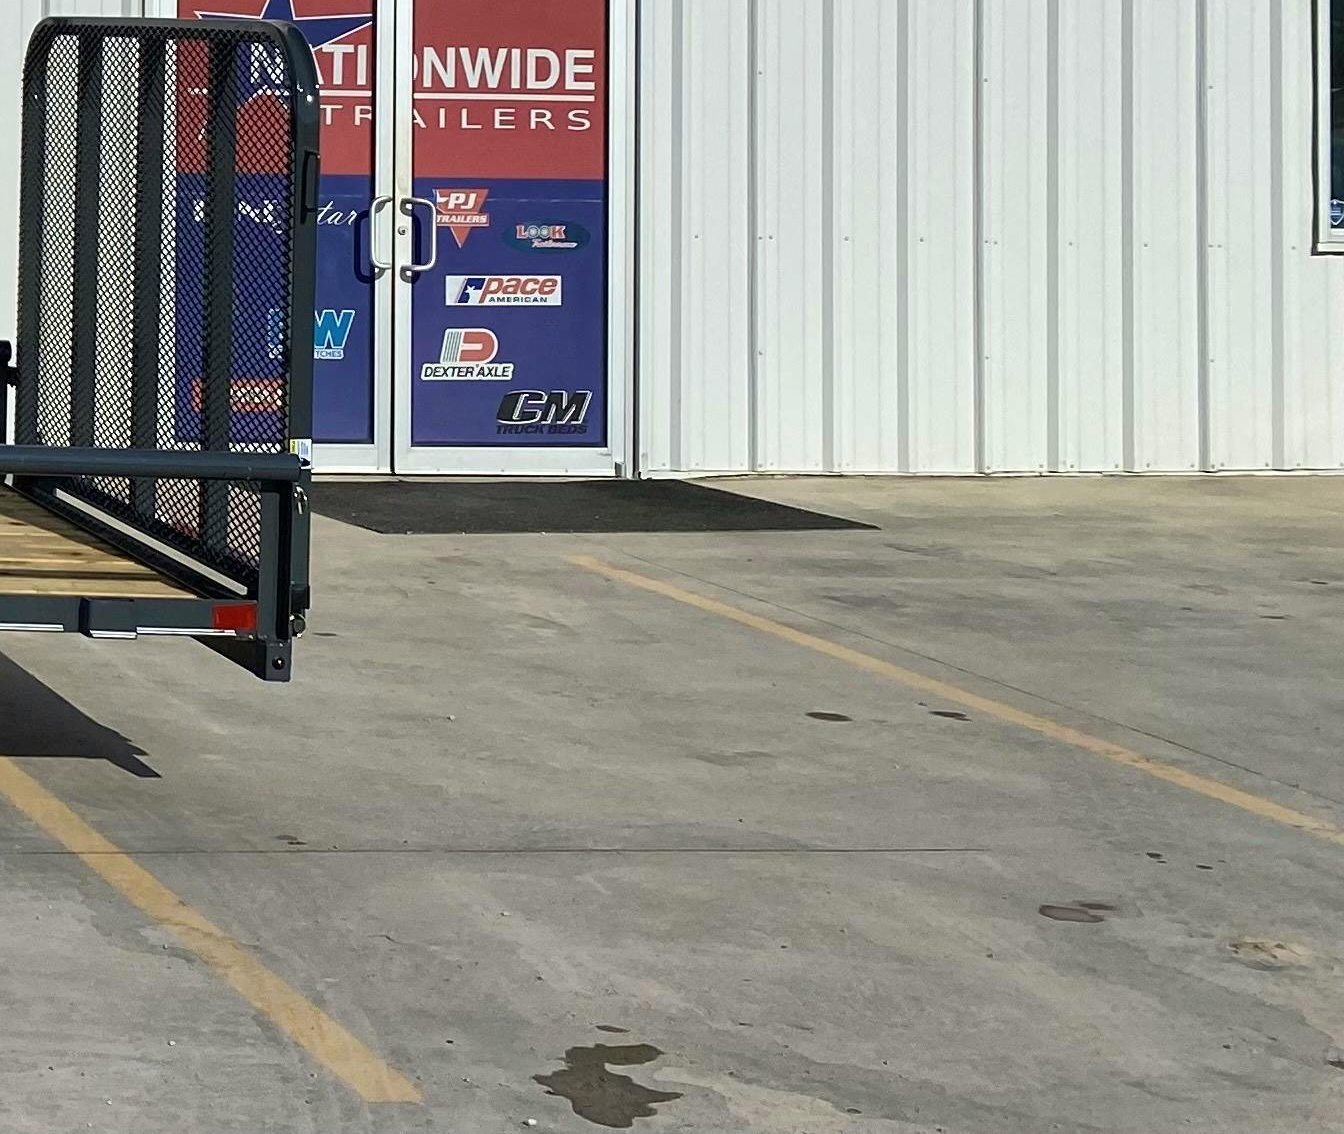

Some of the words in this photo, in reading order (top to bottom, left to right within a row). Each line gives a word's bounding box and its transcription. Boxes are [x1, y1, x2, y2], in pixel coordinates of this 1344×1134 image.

[251, 42, 596, 91] NTINWIDE
[447, 192, 477, 210] PJ
[437, 214, 488, 224] TRAILERS
[516, 224, 567, 239] LOOK
[478, 277, 559, 304] pace
[488, 296, 549, 304] AMERICAN
[423, 366, 475, 378] DEXTER
[476, 366, 512, 378] AXLE
[495, 424, 545, 435] TRUCK
[547, 424, 589, 435] BEDS
